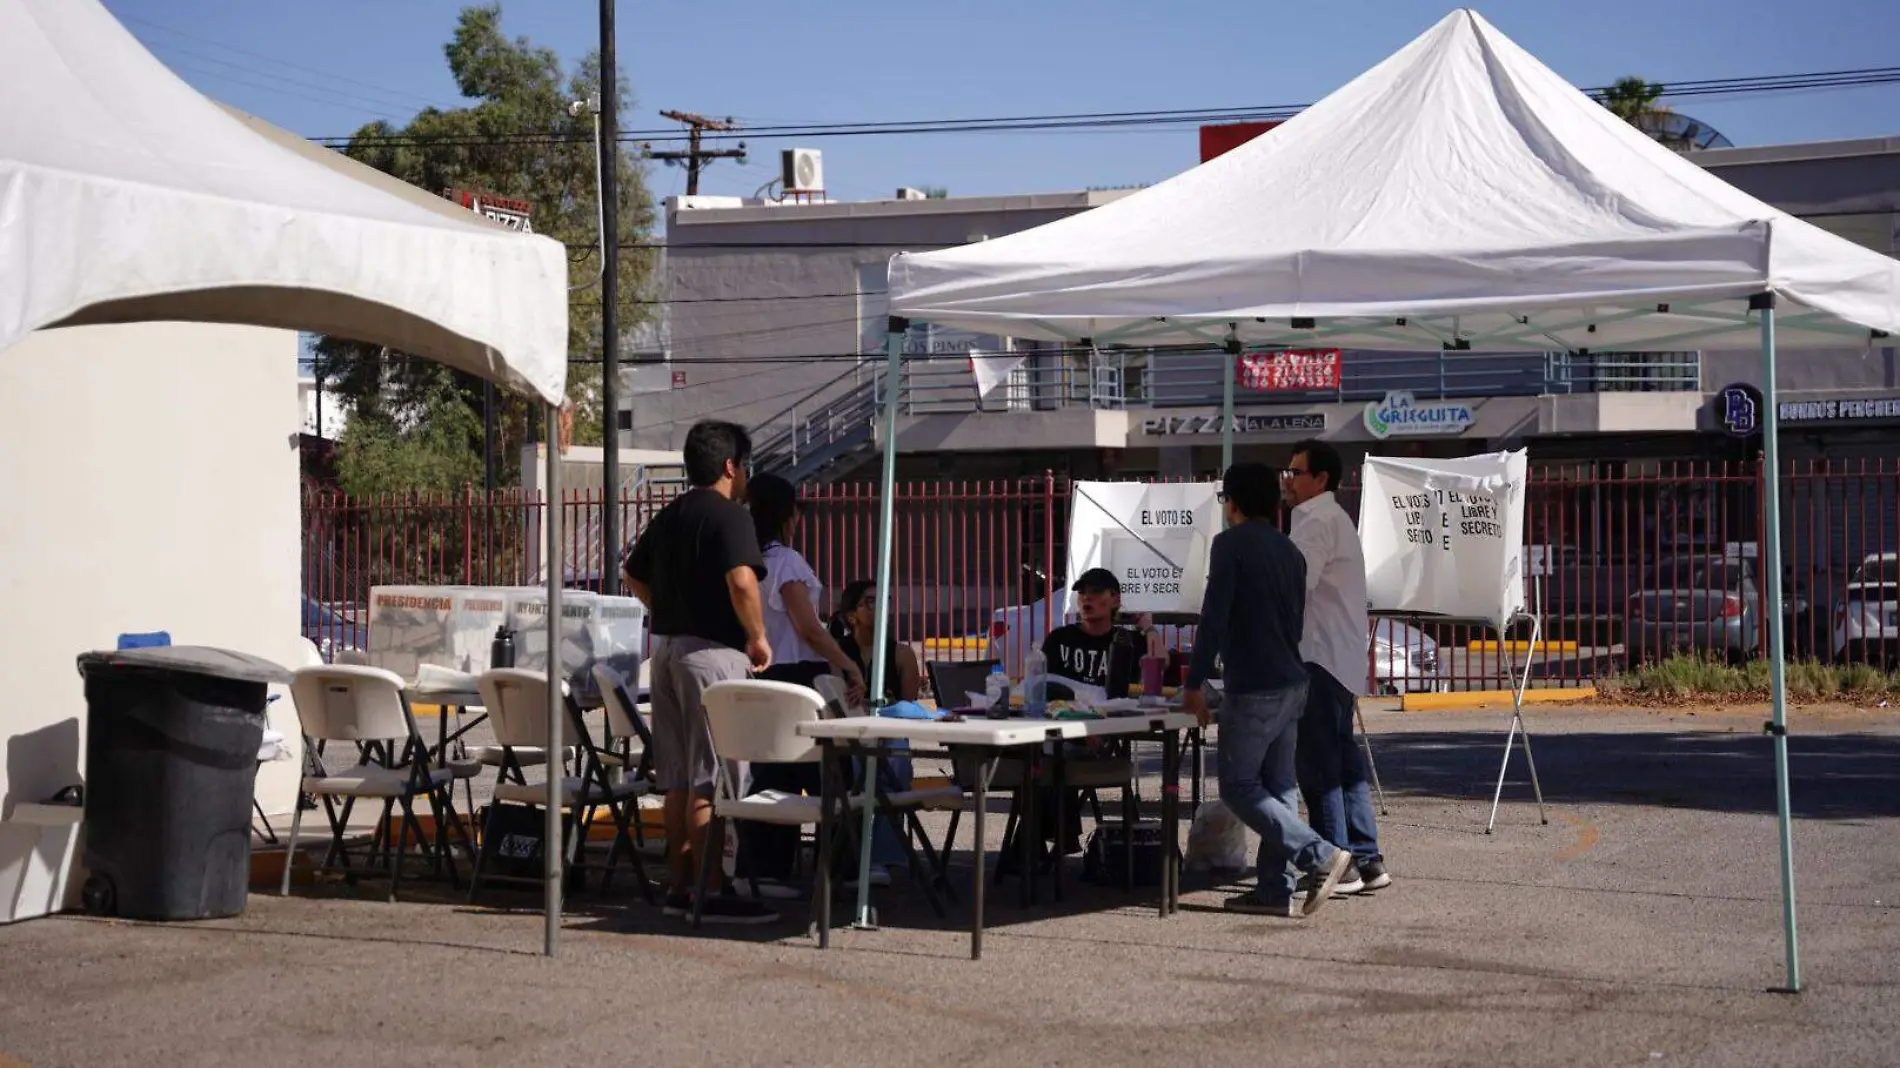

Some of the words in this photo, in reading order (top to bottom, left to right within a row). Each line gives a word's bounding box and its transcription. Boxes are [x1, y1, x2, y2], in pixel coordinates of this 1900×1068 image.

[1390, 396, 1408, 408] LA
[1392, 496, 1406, 509] EL
[1141, 510, 1153, 525] EL
[1155, 510, 1178, 525] VOTO
[1180, 510, 1193, 525] ES
[1461, 505, 1490, 518] LIBRE
[1127, 568, 1140, 579] EL
[1142, 568, 1169, 579] VOTO
[1121, 583, 1141, 594] BRE
[377, 594, 452, 611] PRESIDENCIA
[1060, 643, 1109, 677] VOTA
